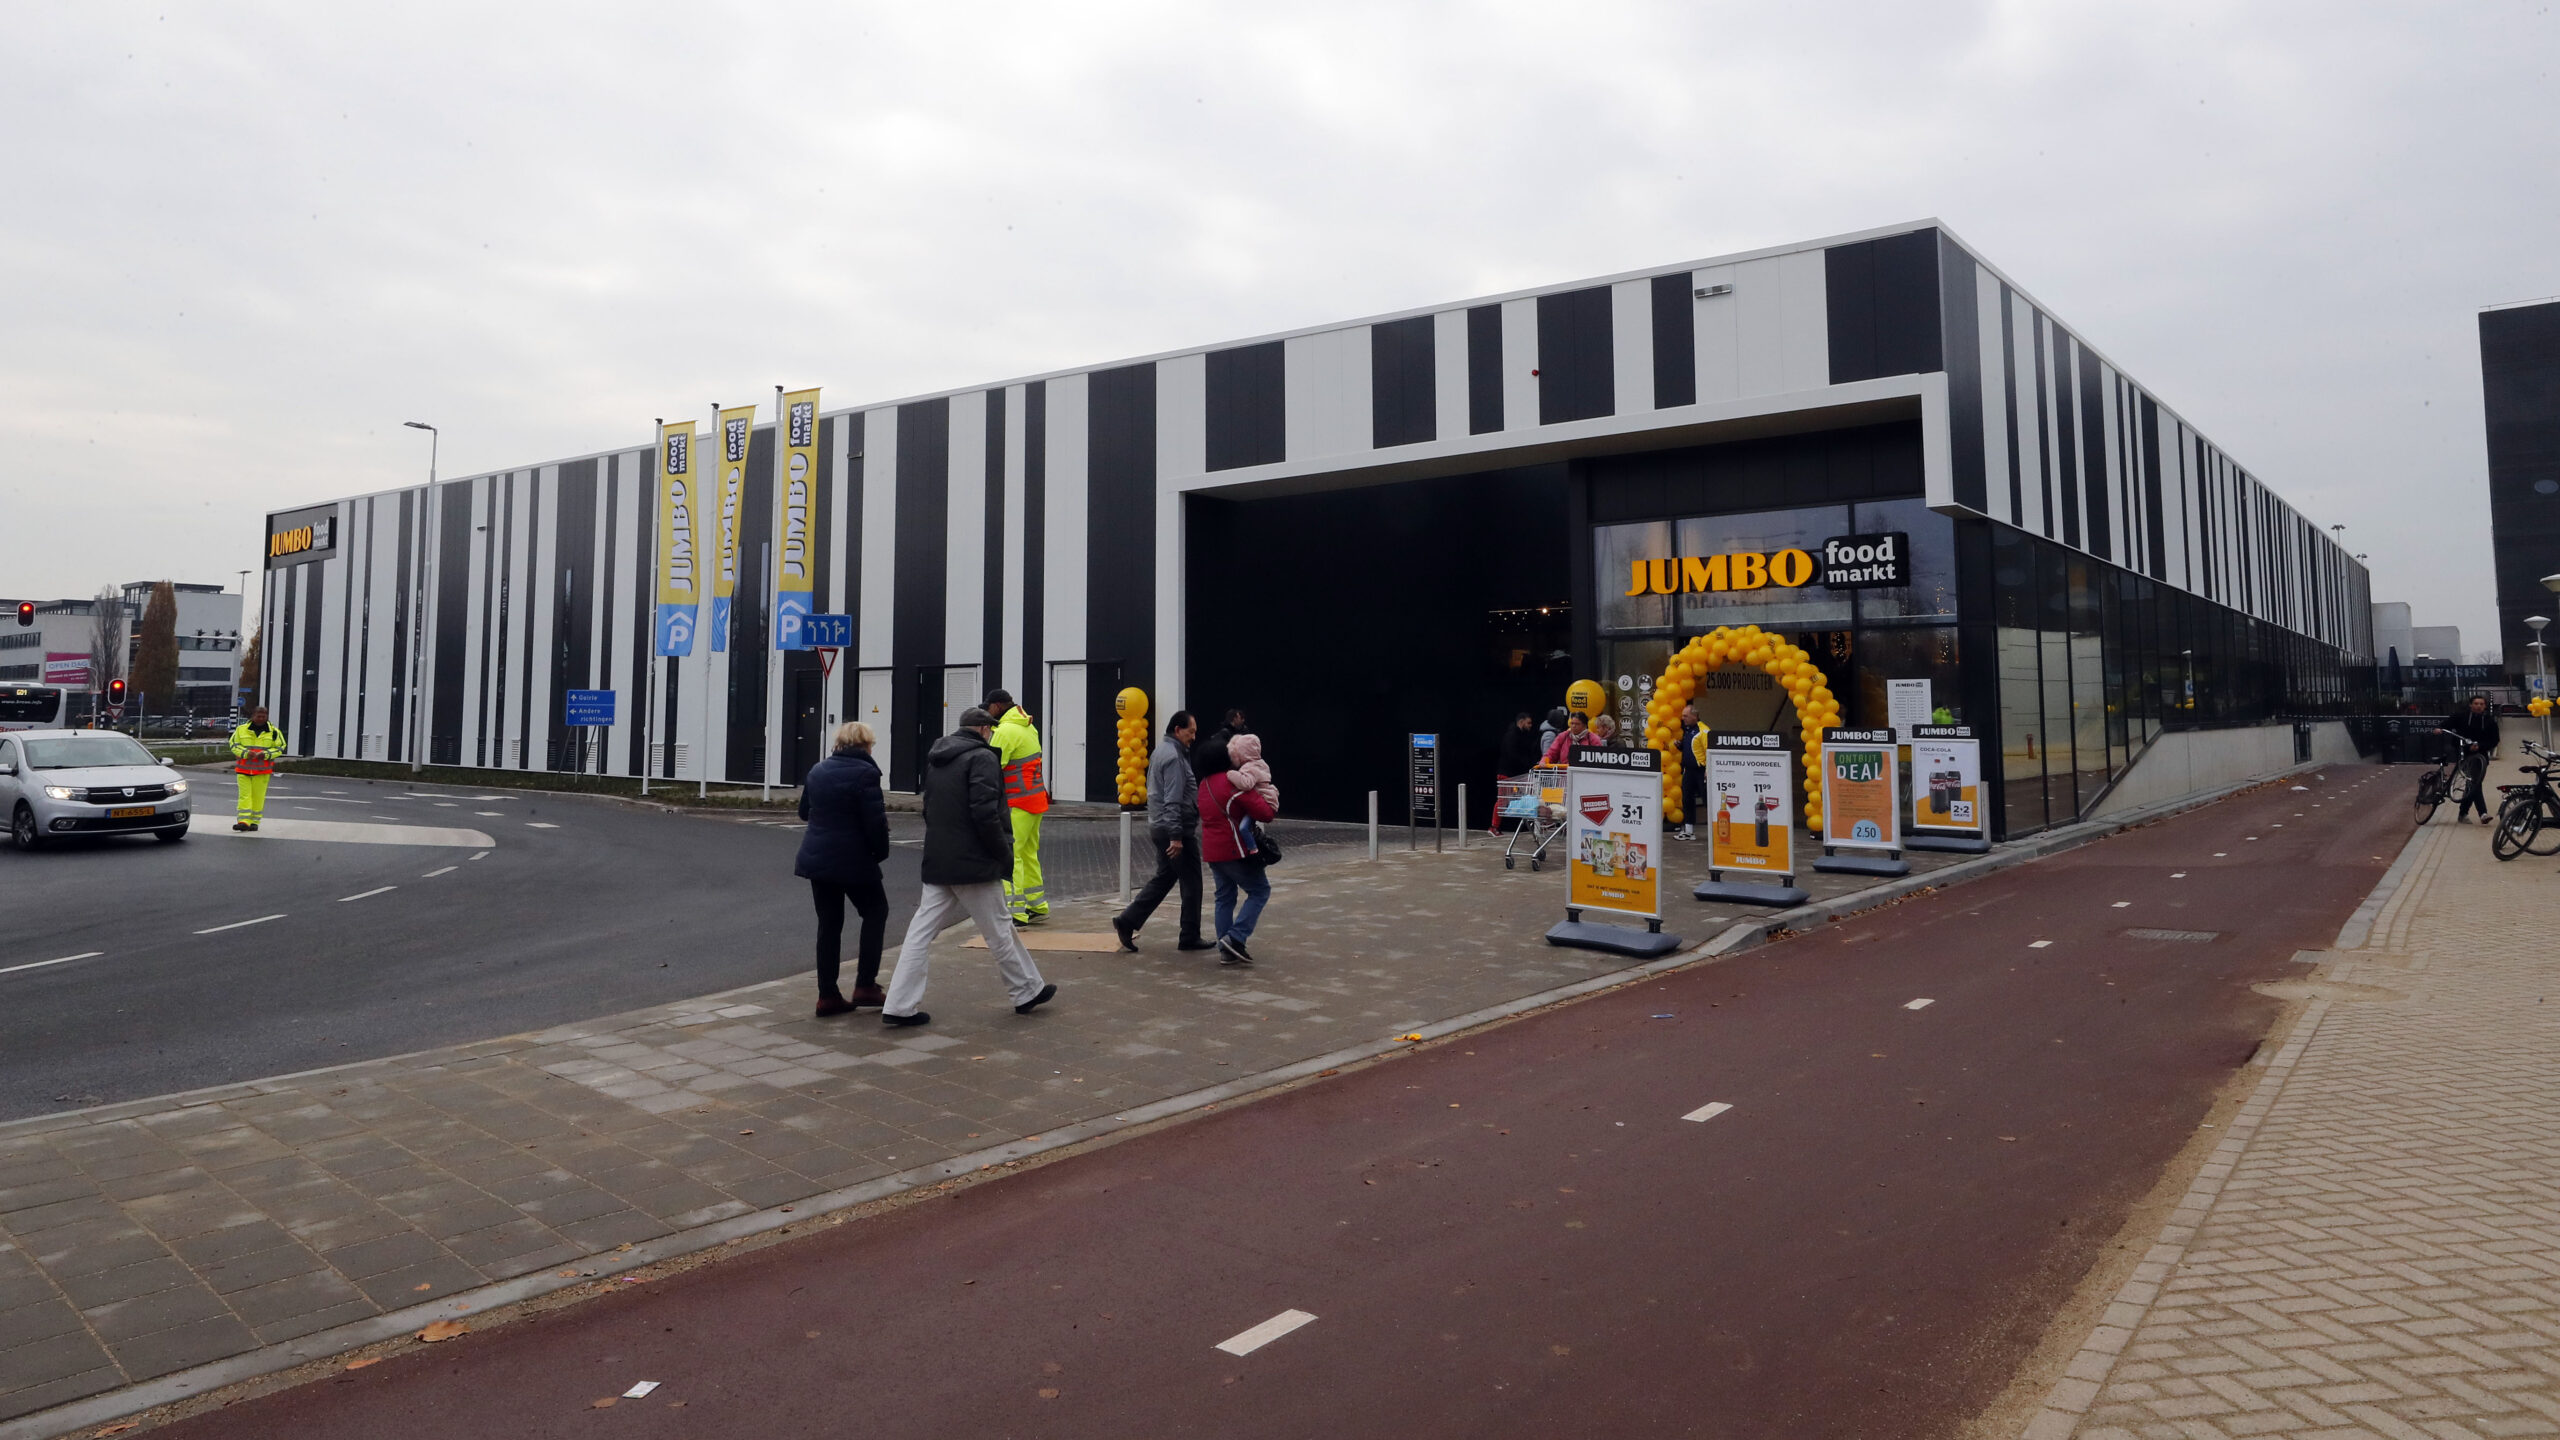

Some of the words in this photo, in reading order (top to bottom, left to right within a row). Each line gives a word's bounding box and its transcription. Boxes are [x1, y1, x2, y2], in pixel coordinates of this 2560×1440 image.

[790, 405, 801, 446] food
[801, 404, 812, 445] markt
[727, 421, 737, 461] food
[737, 418, 746, 459] markt
[669, 436, 679, 473] food
[679, 434, 687, 472] markt
[722, 467, 740, 581] JUMBO
[784, 453, 808, 579] JUMBO
[269, 526, 312, 557] JUMBO
[313, 519, 329, 537] food
[670, 480, 693, 593] JUMBO
[1625, 548, 1813, 596] JUMBO
[1826, 536, 1896, 565] food
[1827, 563, 1896, 583] markt
[1706, 672, 1731, 689] 25.000
[1732, 672, 1773, 690] PRODUCTEN
[1716, 736, 1761, 746] JUMBO
[1830, 731, 1871, 740] JUMBO
[1920, 728, 1955, 736] JUMBO
[1579, 751, 1629, 765] JUMBO
[1839, 754, 1877, 764] ONTBIJT
[1836, 762, 1883, 780] DEAL
[1622, 804, 1643, 820] 3+1
[1953, 805, 1970, 814] 2+2
[1856, 827, 1876, 838] 2.50
[1736, 856, 1766, 865] JUMBO
